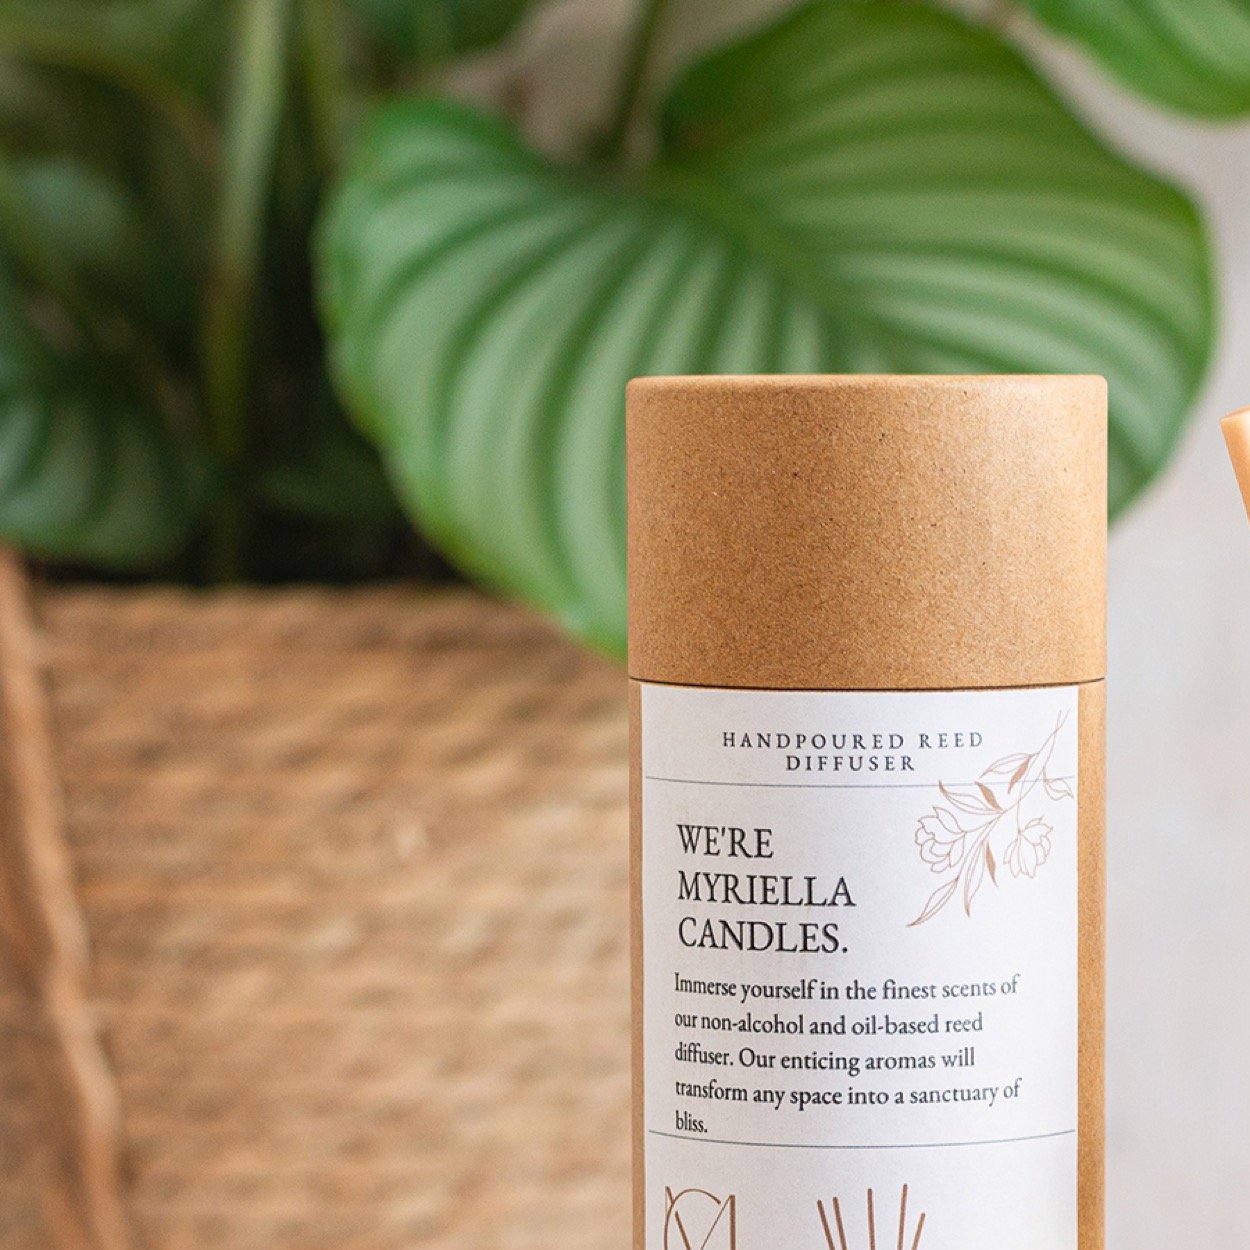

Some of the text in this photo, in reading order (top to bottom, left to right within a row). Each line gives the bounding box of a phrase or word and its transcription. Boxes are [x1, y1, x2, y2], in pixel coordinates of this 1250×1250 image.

[722, 731, 984, 750] HANDPOURED REED
[785, 754, 915, 772] DIFFUSER
[676, 823, 775, 859] WE'RE
[677, 870, 857, 908] MYRIELLA
[678, 916, 849, 954] CANDLES.
[674, 972, 1022, 1004] Immerse yourself in the finest scents of
[674, 1011, 984, 1036] our non-alcohol and oil-based reed
[674, 1041, 976, 1077] diffuser. Our enticing aromas will
[675, 1077, 1023, 1111] transform any space into a sanctuary of
[675, 1110, 708, 1134] bliss.
